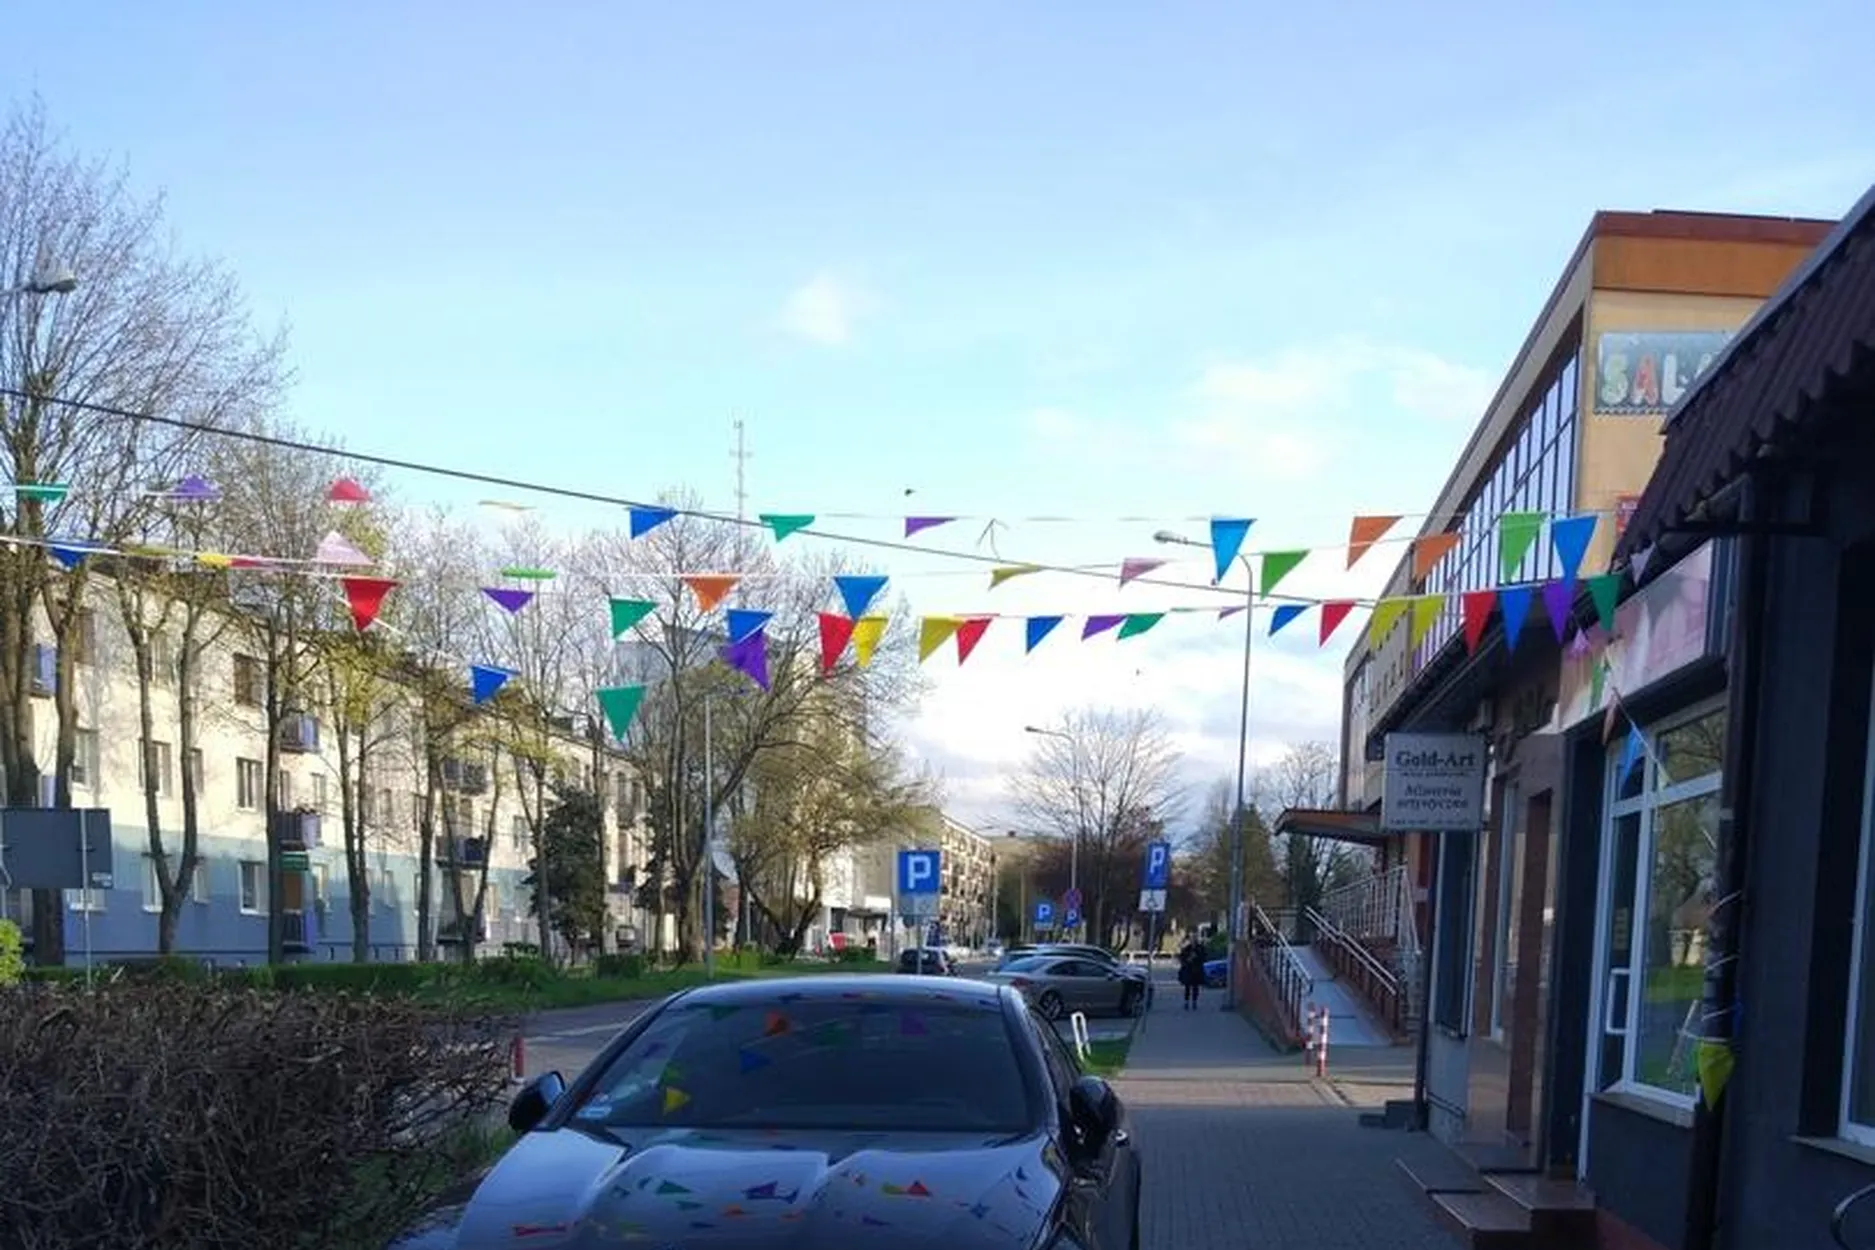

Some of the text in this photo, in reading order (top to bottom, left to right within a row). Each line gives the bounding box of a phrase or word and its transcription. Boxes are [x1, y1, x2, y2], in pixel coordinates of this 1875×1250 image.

[1395, 750, 1476, 767] Gold-Art
[908, 854, 931, 889] P
[1150, 847, 1166, 874] P
[1038, 904, 1051, 919] P
